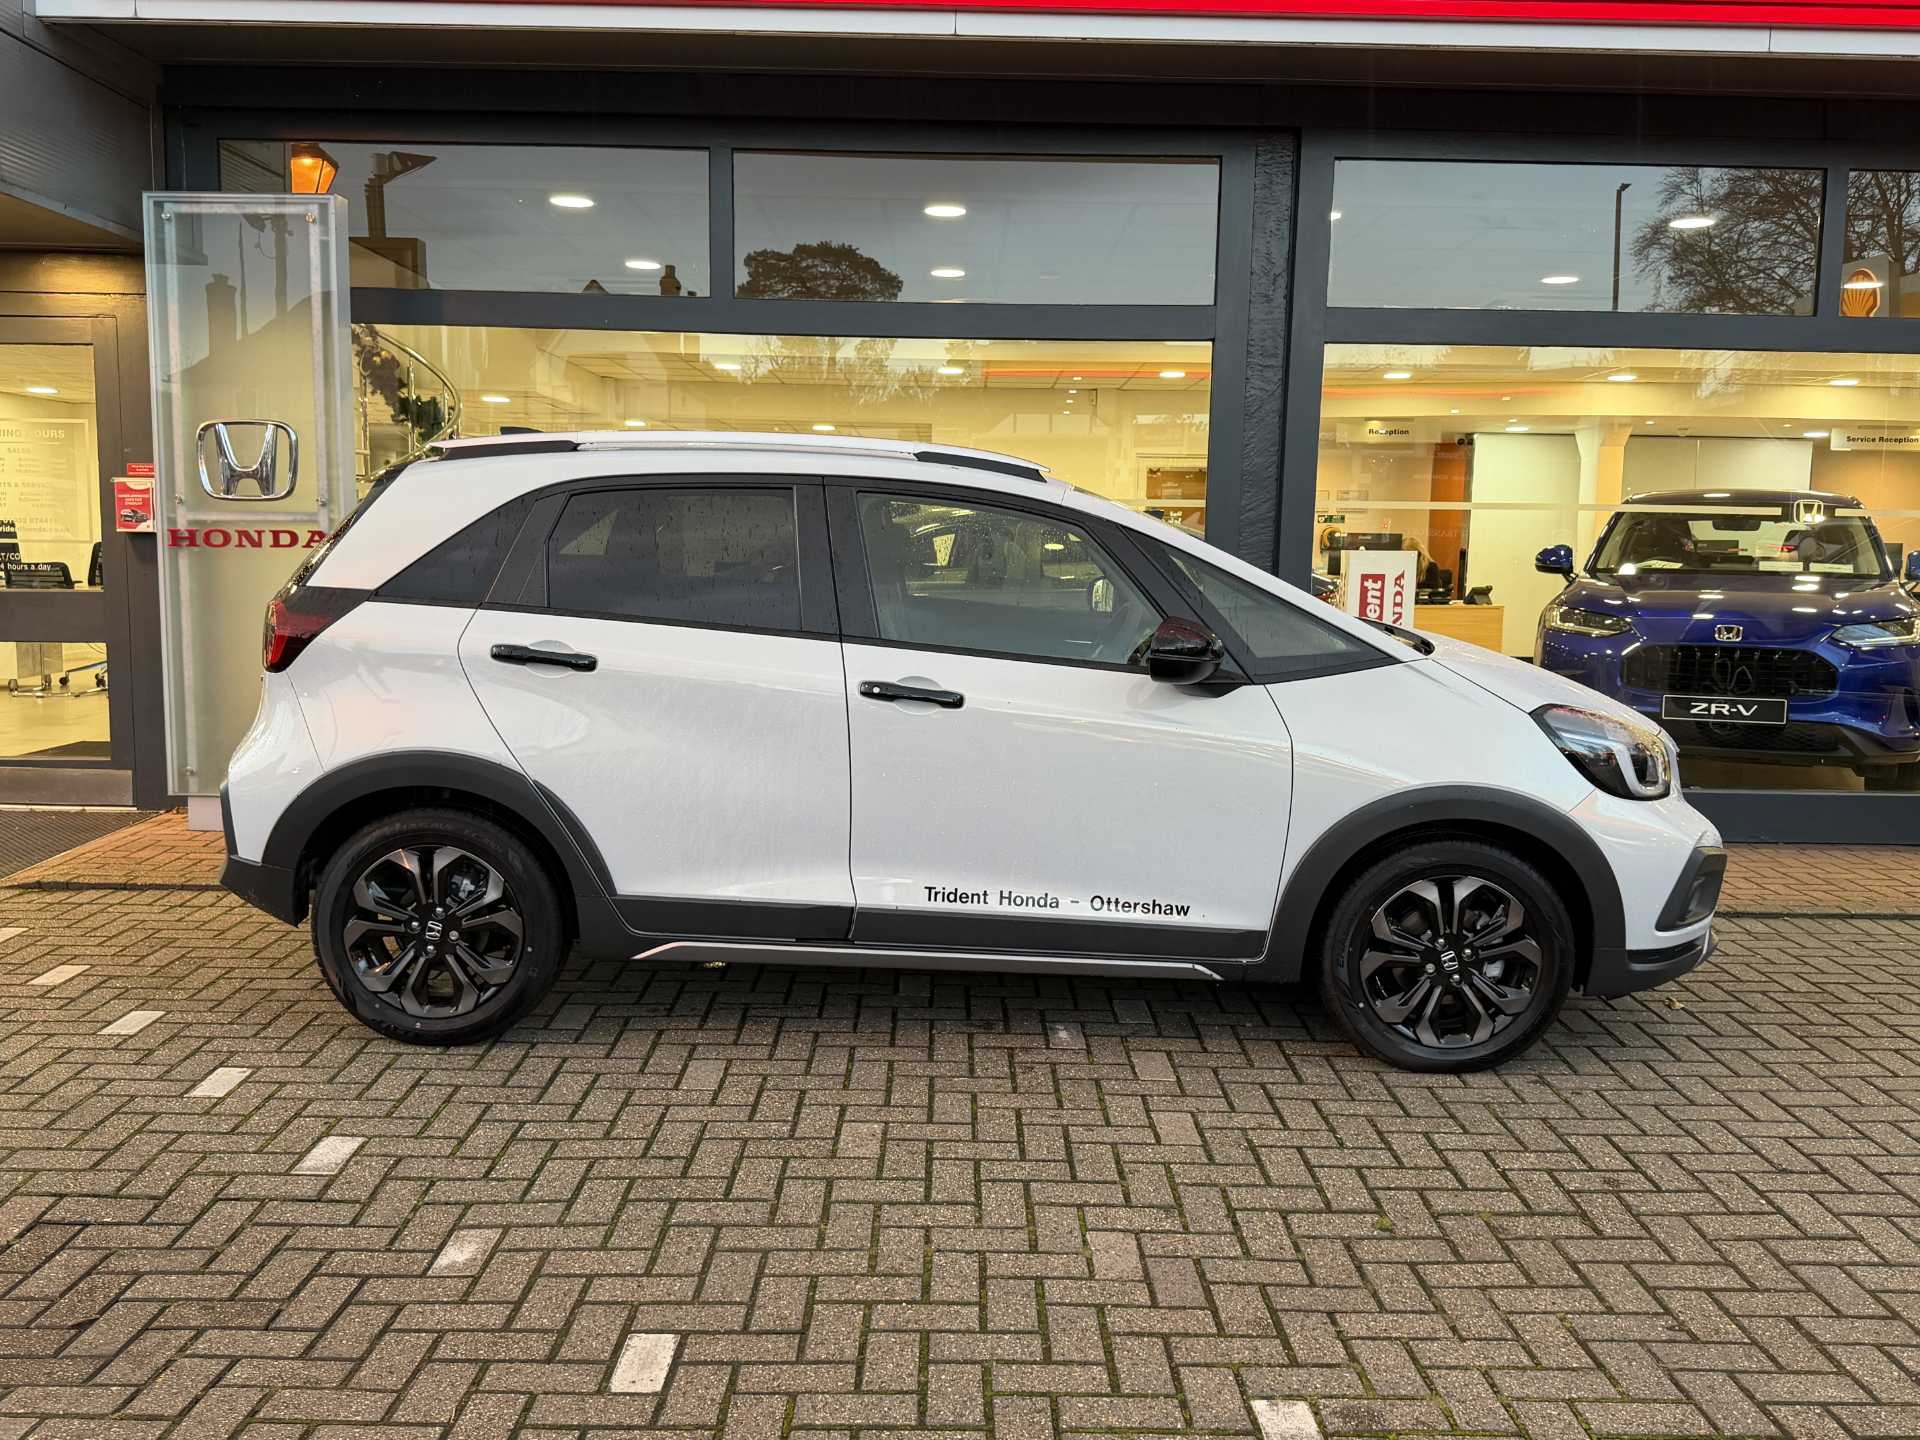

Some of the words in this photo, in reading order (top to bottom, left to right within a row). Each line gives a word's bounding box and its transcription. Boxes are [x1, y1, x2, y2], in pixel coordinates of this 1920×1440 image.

[1846, 435, 1877, 443] Service
[168, 528, 330, 549] HONDA
[7, 563, 28, 571] hours
[1689, 702, 1758, 716] ZR-V
[924, 885, 990, 905] Trident
[998, 889, 1060, 909] Honda
[1089, 894, 1192, 917] Ottershaw
